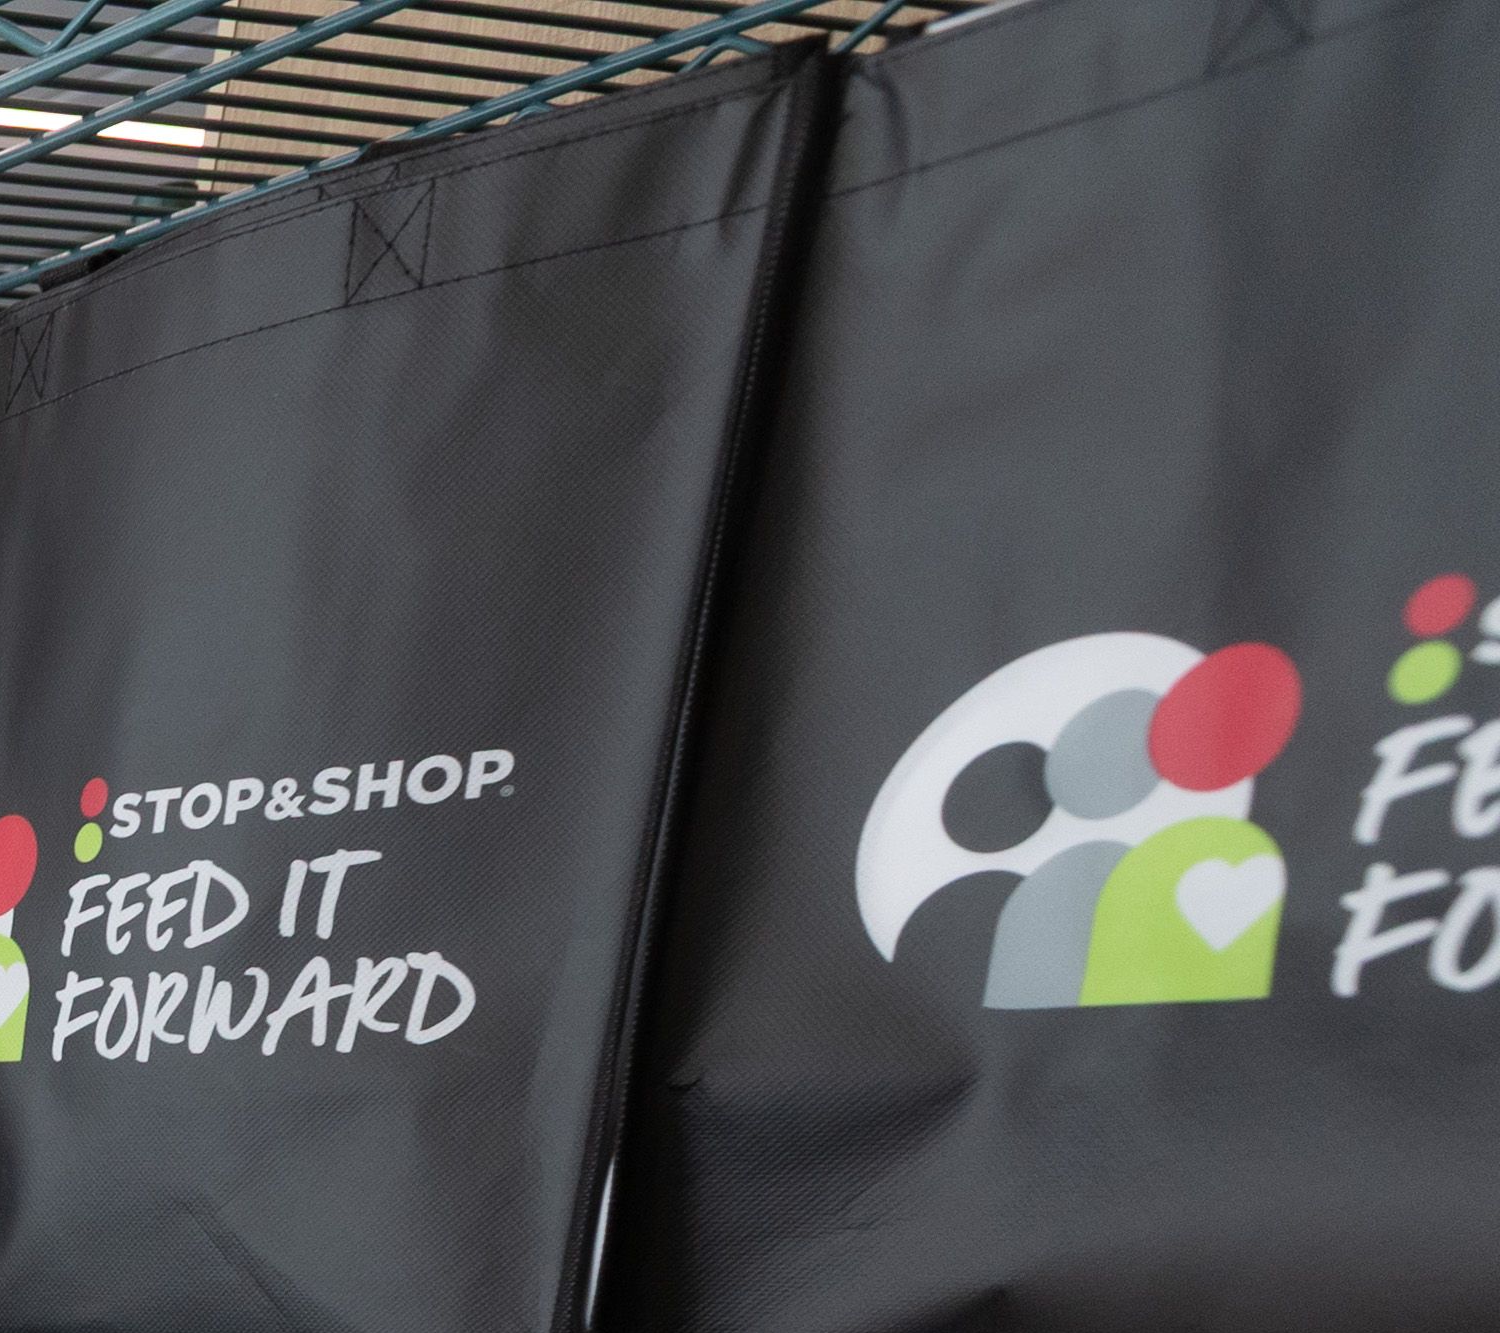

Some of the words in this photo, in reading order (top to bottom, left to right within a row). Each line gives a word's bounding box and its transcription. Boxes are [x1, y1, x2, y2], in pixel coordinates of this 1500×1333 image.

[109, 749, 515, 839] STOP&SHOP
[1354, 715, 1500, 845] FE
[60, 859, 249, 957] FEED
[278, 849, 382, 940] IT
[52, 952, 476, 1063] FORWARD
